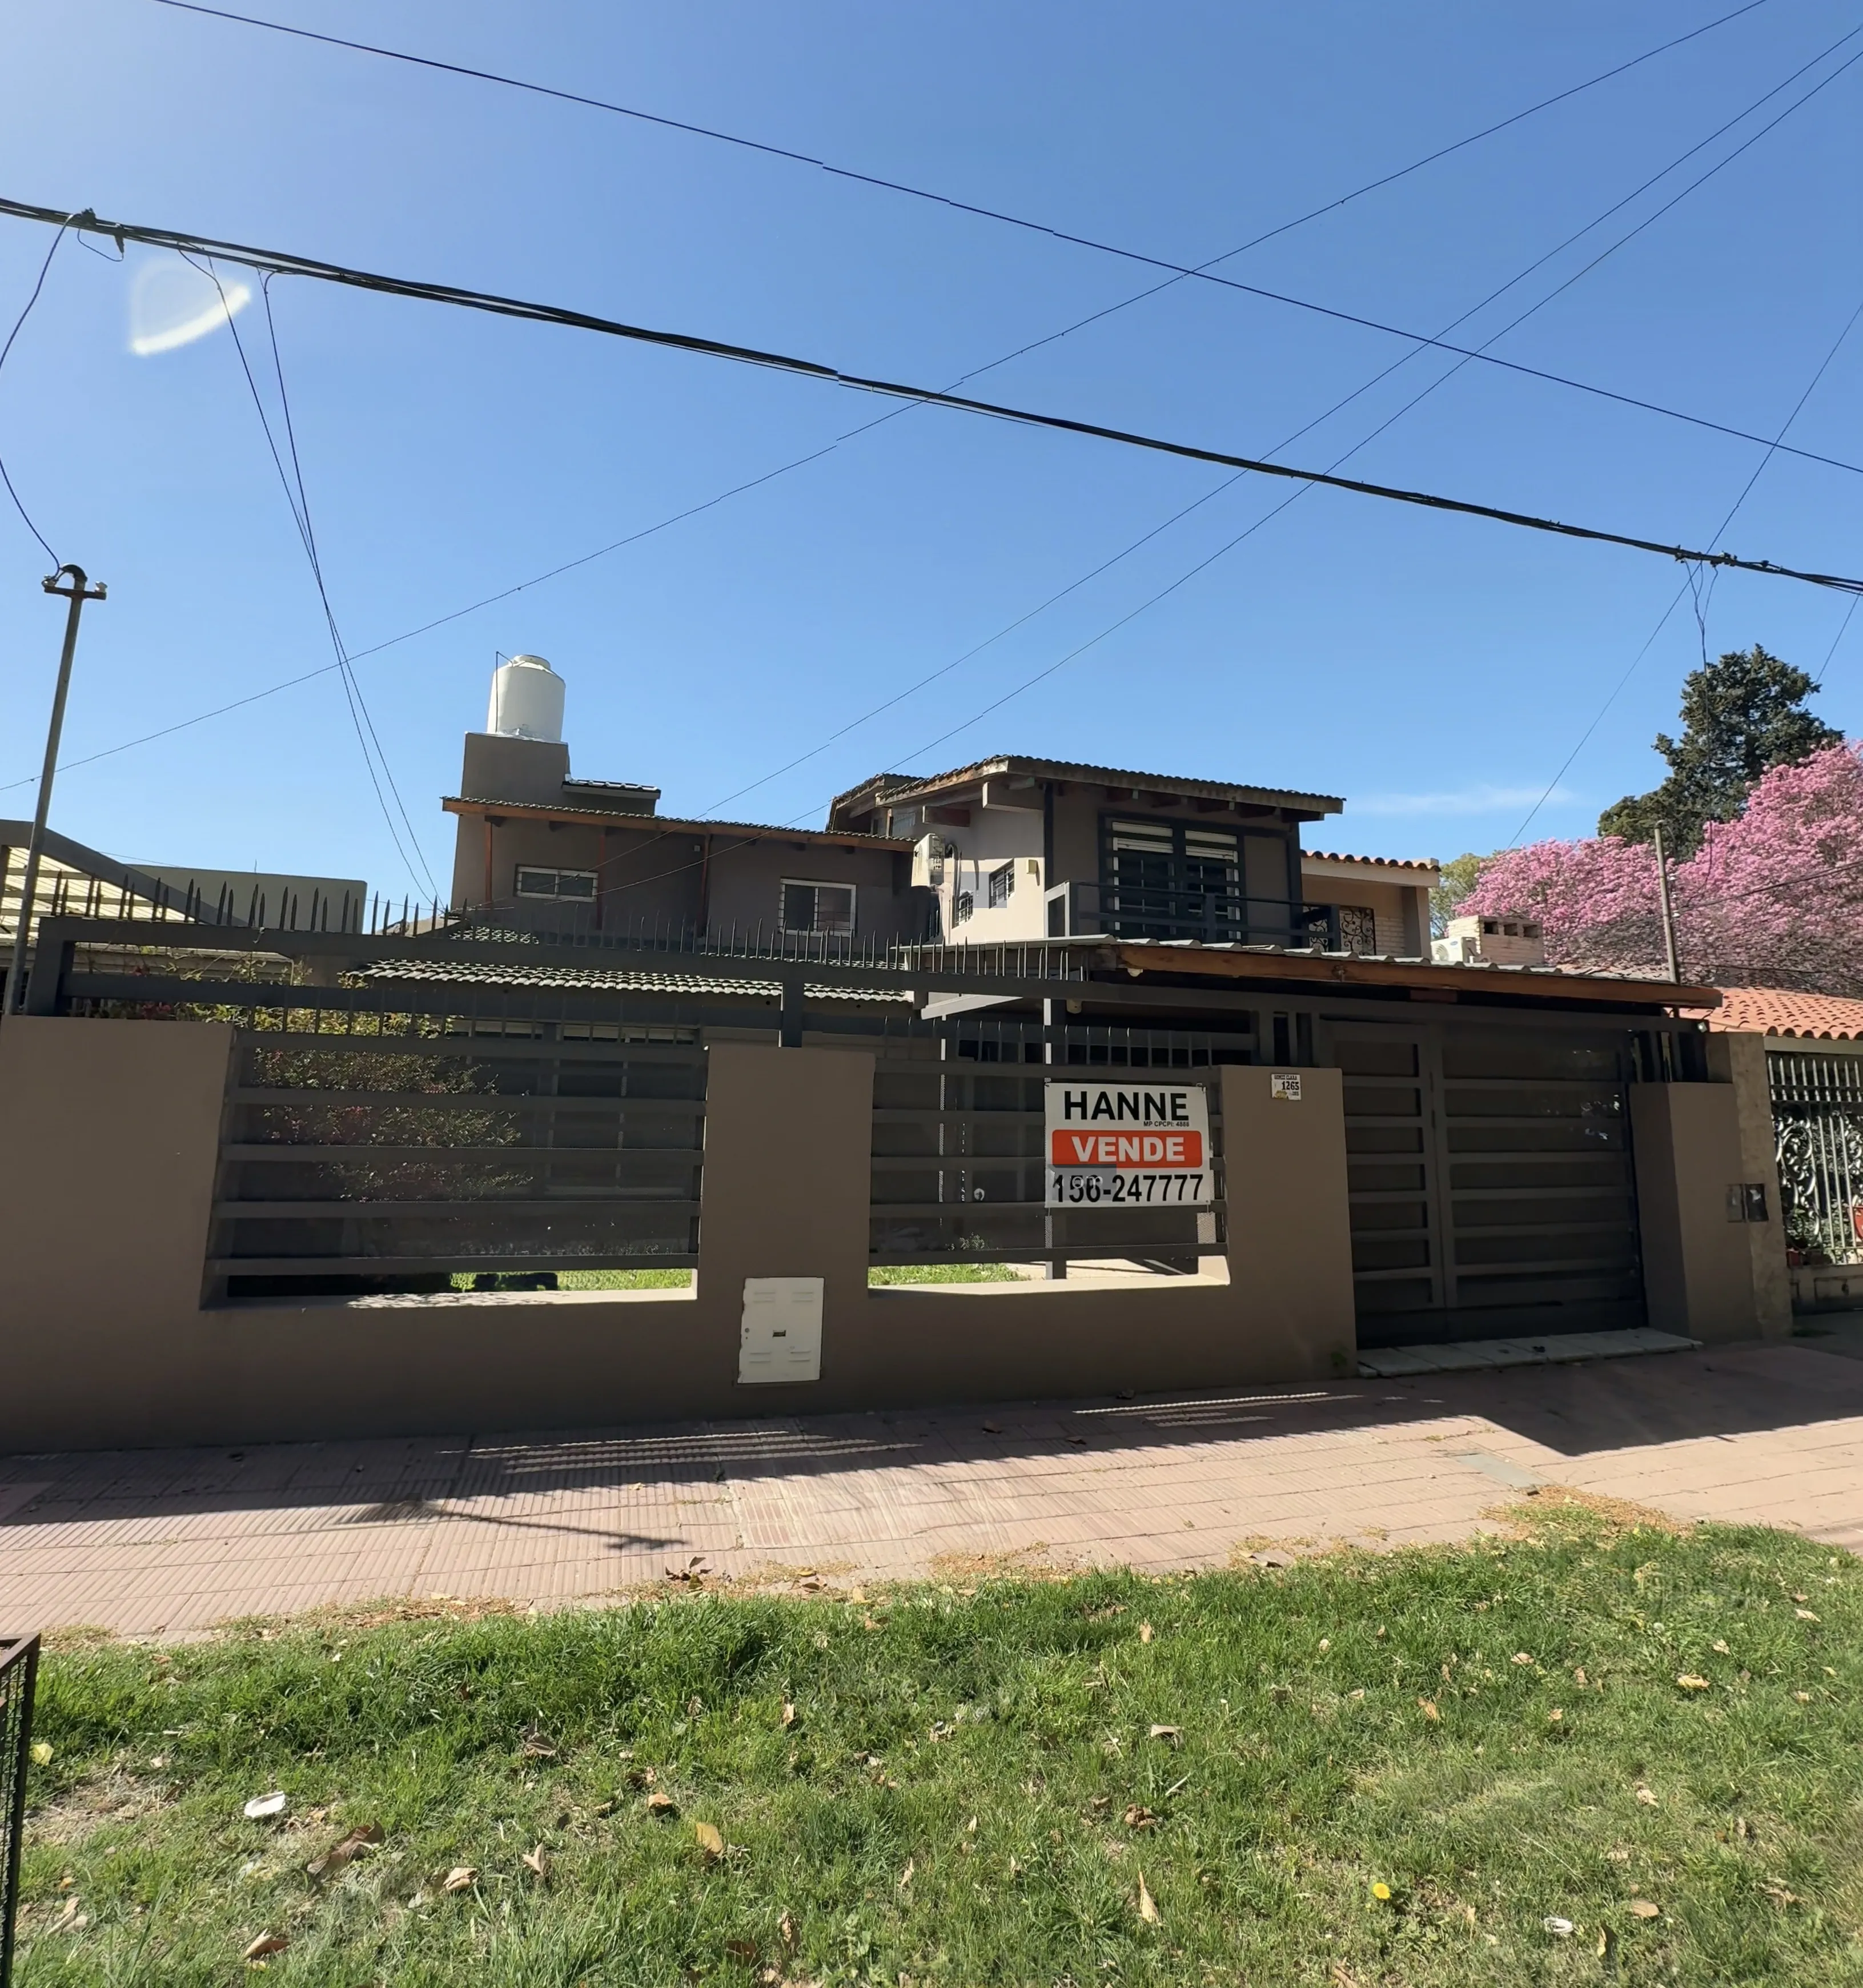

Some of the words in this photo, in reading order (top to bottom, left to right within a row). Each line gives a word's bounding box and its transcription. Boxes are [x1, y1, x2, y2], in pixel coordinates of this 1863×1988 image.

[1282, 1081, 1299, 1090] 1265
[1065, 1091, 1189, 1120] HANNE
[1071, 1136, 1185, 1163] VENDE
[1053, 1174, 1203, 1203] 156-247777
